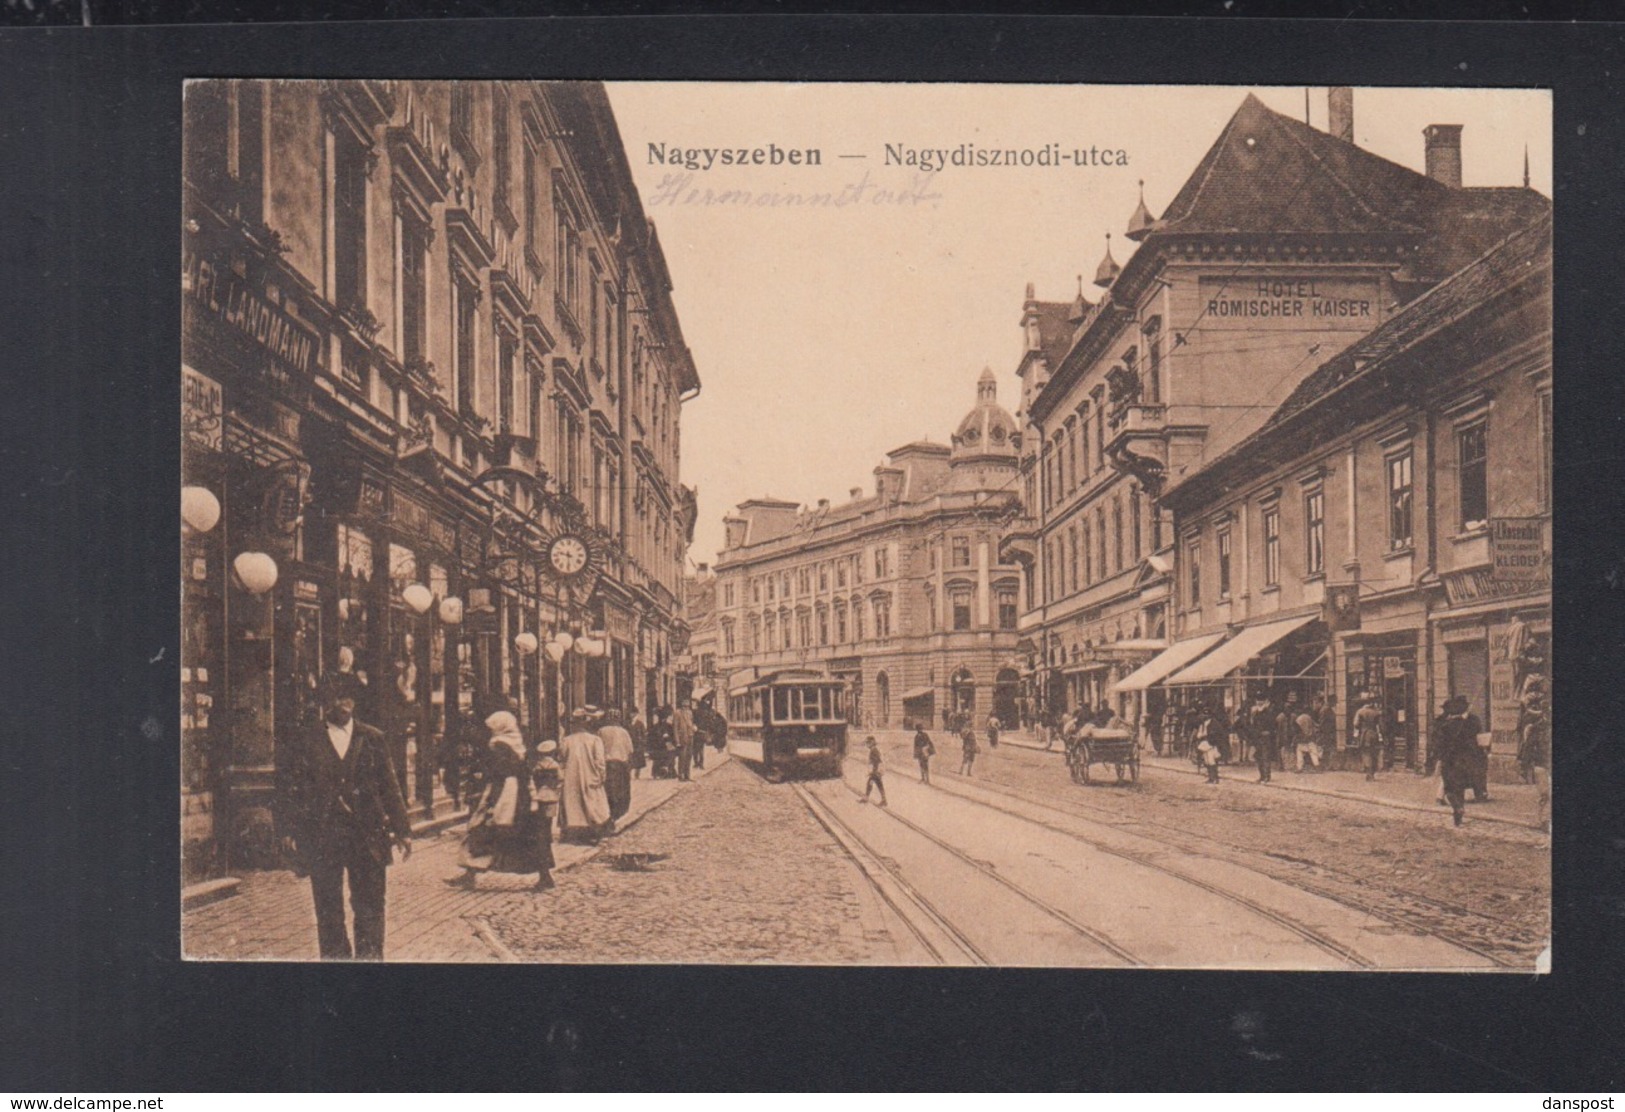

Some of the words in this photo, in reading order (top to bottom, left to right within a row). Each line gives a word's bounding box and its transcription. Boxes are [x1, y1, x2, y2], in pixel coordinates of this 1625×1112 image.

[648, 142, 821, 171] Nagyszeben
[885, 143, 1128, 172] Nagydisznodi-utca
[1257, 281, 1321, 298] HOTEL
[1207, 295, 1304, 317] RÖMISCHER
[1312, 299, 1371, 317] KAISER
[226, 281, 311, 373] LANDMANN
[1495, 554, 1541, 567] KLEIDER
